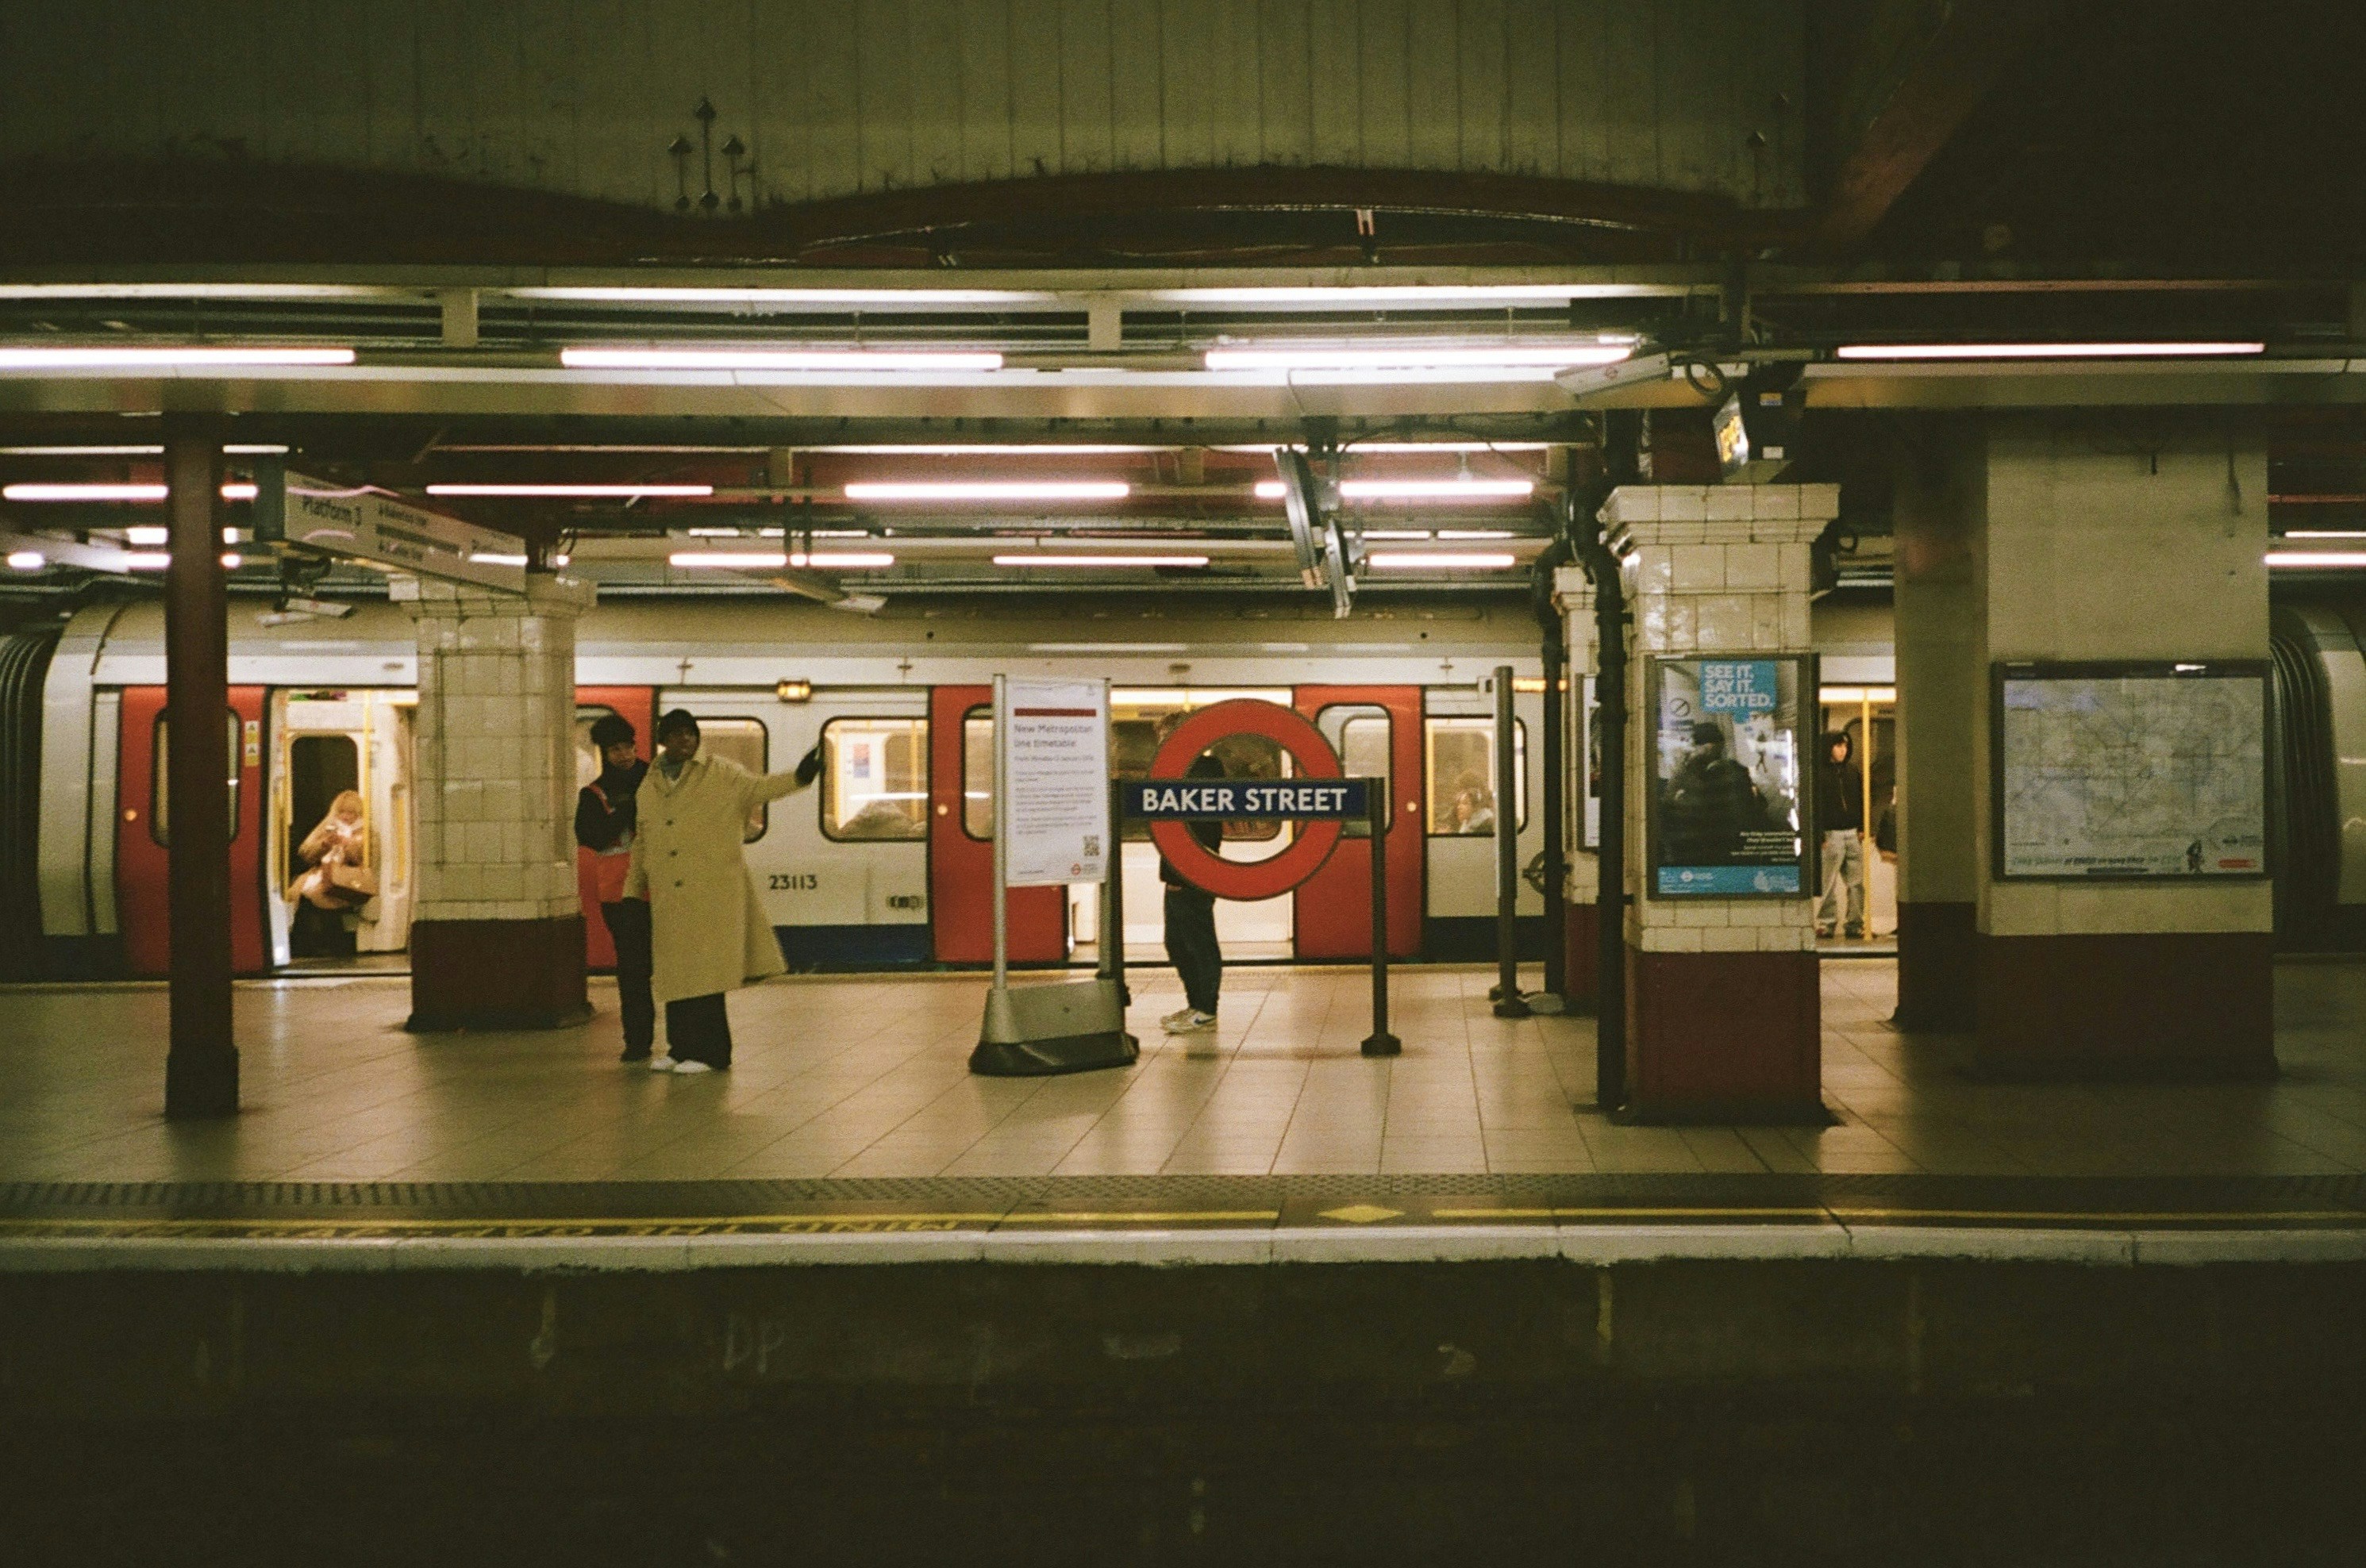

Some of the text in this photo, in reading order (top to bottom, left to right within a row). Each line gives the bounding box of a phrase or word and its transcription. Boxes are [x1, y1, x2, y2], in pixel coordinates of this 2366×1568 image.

[1705, 665, 1754, 678] SEE IT.
[1705, 679, 1754, 693] SAY IT.
[1705, 693, 1775, 707] SORTED.
[1014, 724, 1095, 735] New Metropolitan
[1033, 739, 1077, 748] timetable
[1141, 787, 1348, 813] BAKER STREET
[768, 874, 818, 890] 23113
